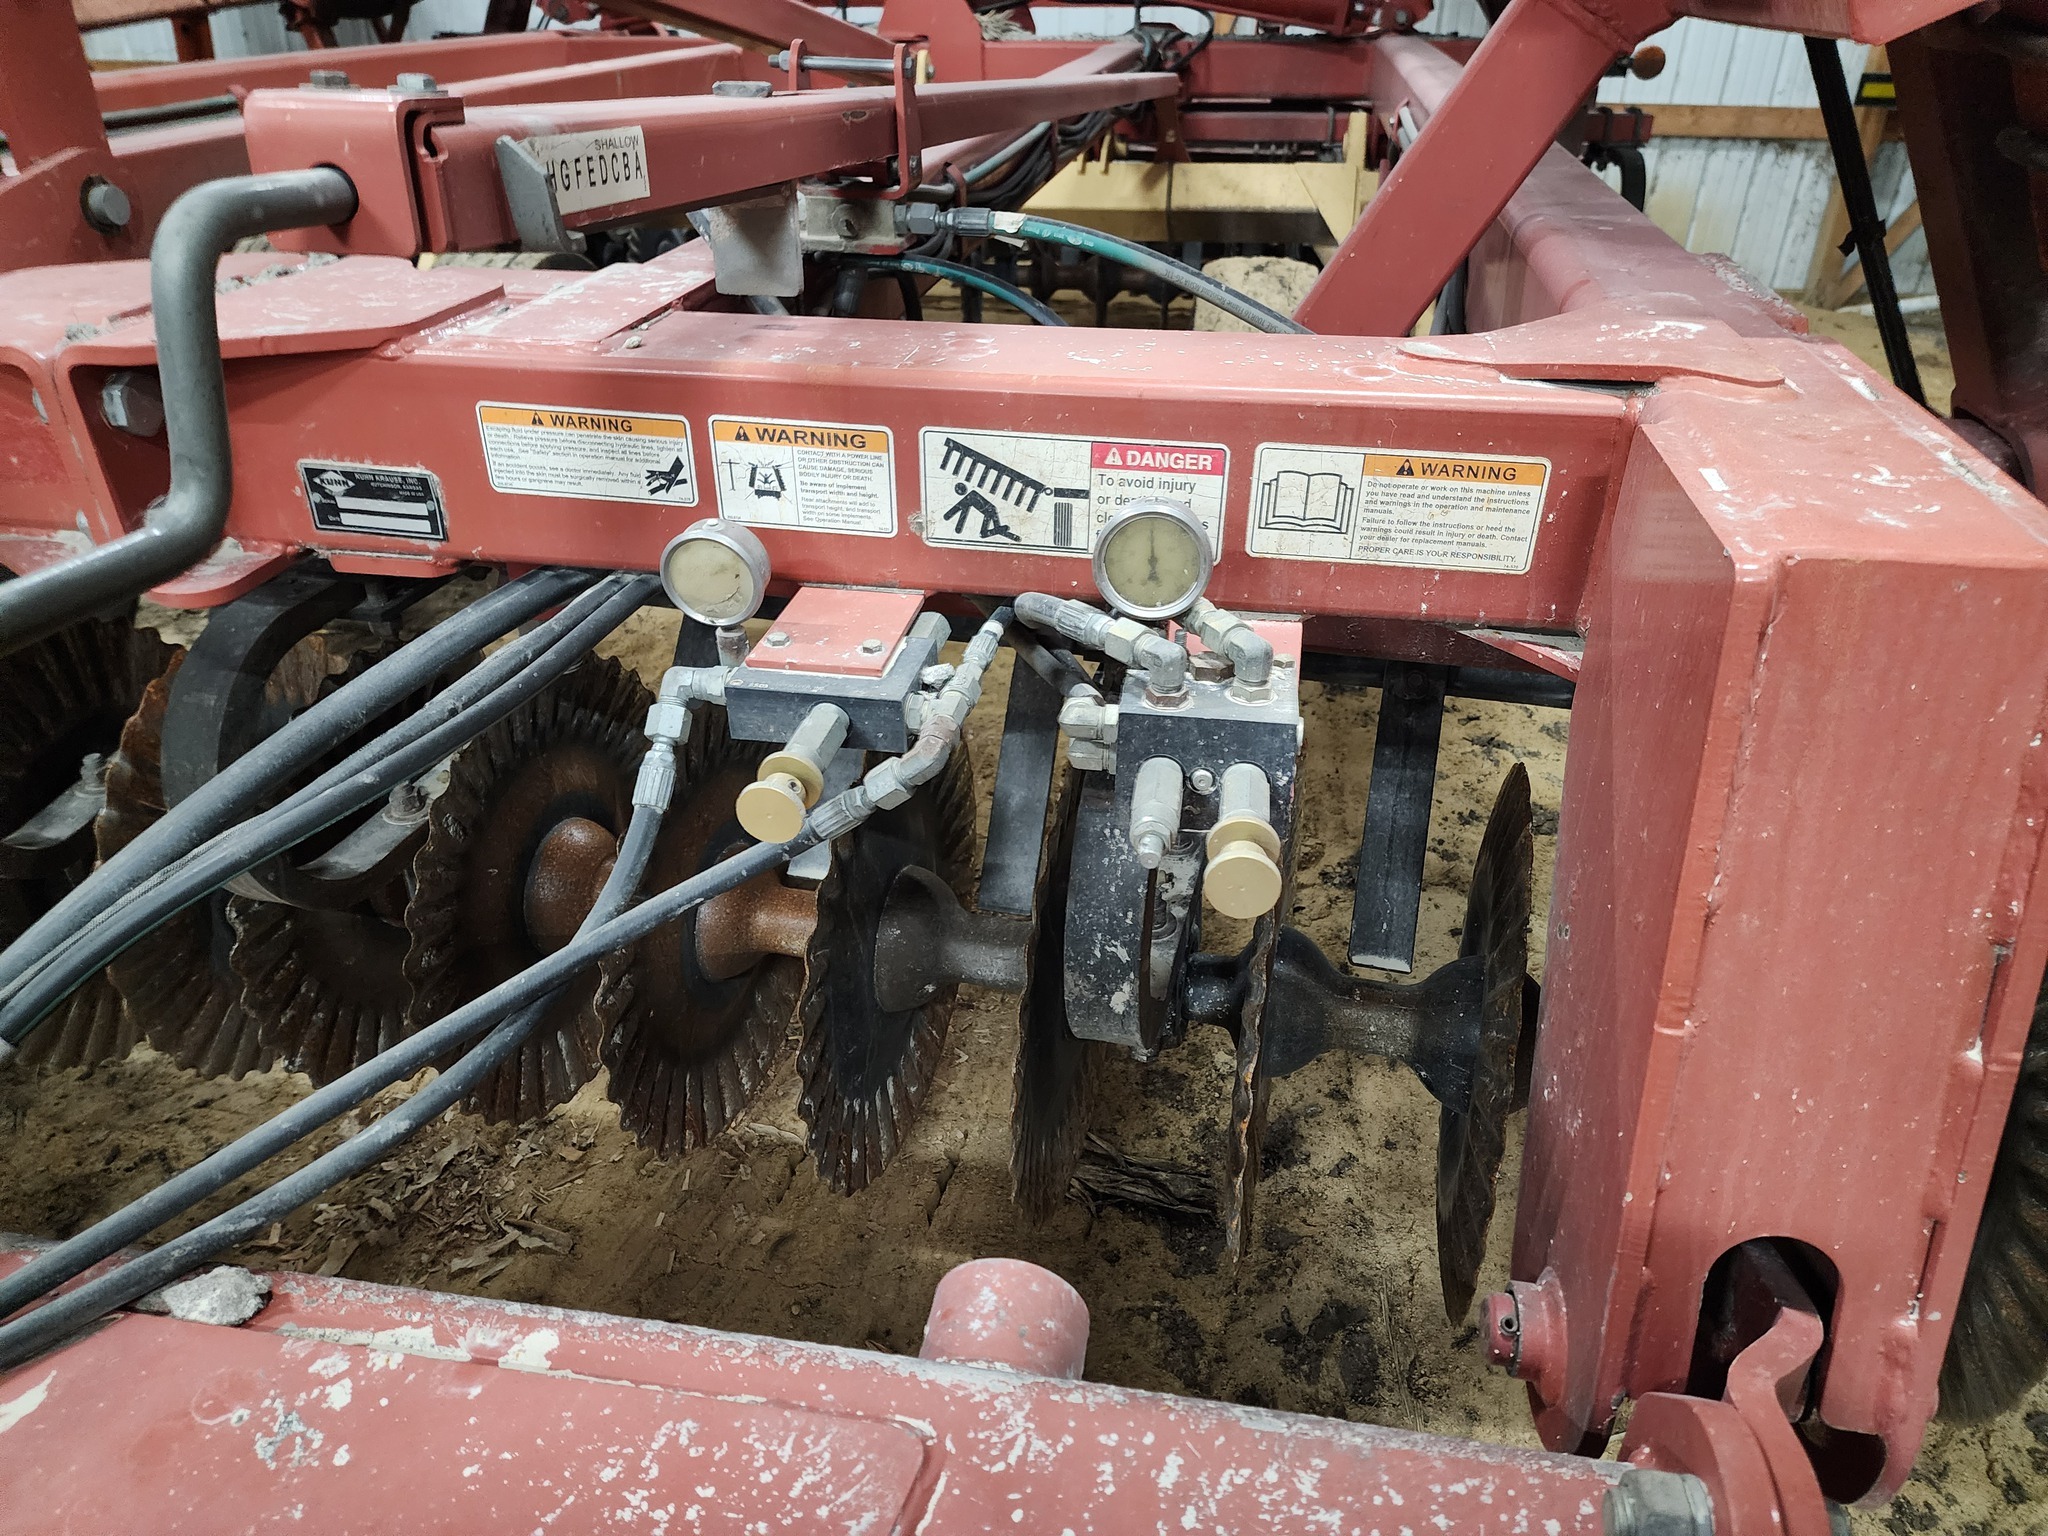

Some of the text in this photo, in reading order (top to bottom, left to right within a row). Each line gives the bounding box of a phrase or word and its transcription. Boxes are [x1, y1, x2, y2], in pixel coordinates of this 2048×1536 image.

[594, 135, 639, 151] SHALLOW
[550, 414, 633, 432] WARNING
[755, 427, 866, 448] WARNING
[828, 458, 871, 466] OBSTRUCTION
[1126, 450, 1212, 470] DANGER
[1422, 463, 1517, 480] WARNING
[1098, 474, 1196, 494] To avoid injury
[1097, 496, 1111, 504] or
[1432, 493, 1472, 502] understand
[1486, 496, 1529, 505] instructions
[1380, 500, 1411, 509] warnings
[1485, 506, 1531, 515] maintenance
[1361, 525, 1392, 534] warnings
[1445, 530, 1466, 540] injury
[1500, 534, 1528, 542] Contact
[1433, 521, 1474, 530] instructions
[1411, 537, 1455, 545] replacement
[1358, 544, 1391, 553] PROPER
[1393, 547, 1414, 555] CARE
[1426, 549, 1449, 558] YOUR
[1450, 551, 1517, 562] RESPONSIBILITY.
